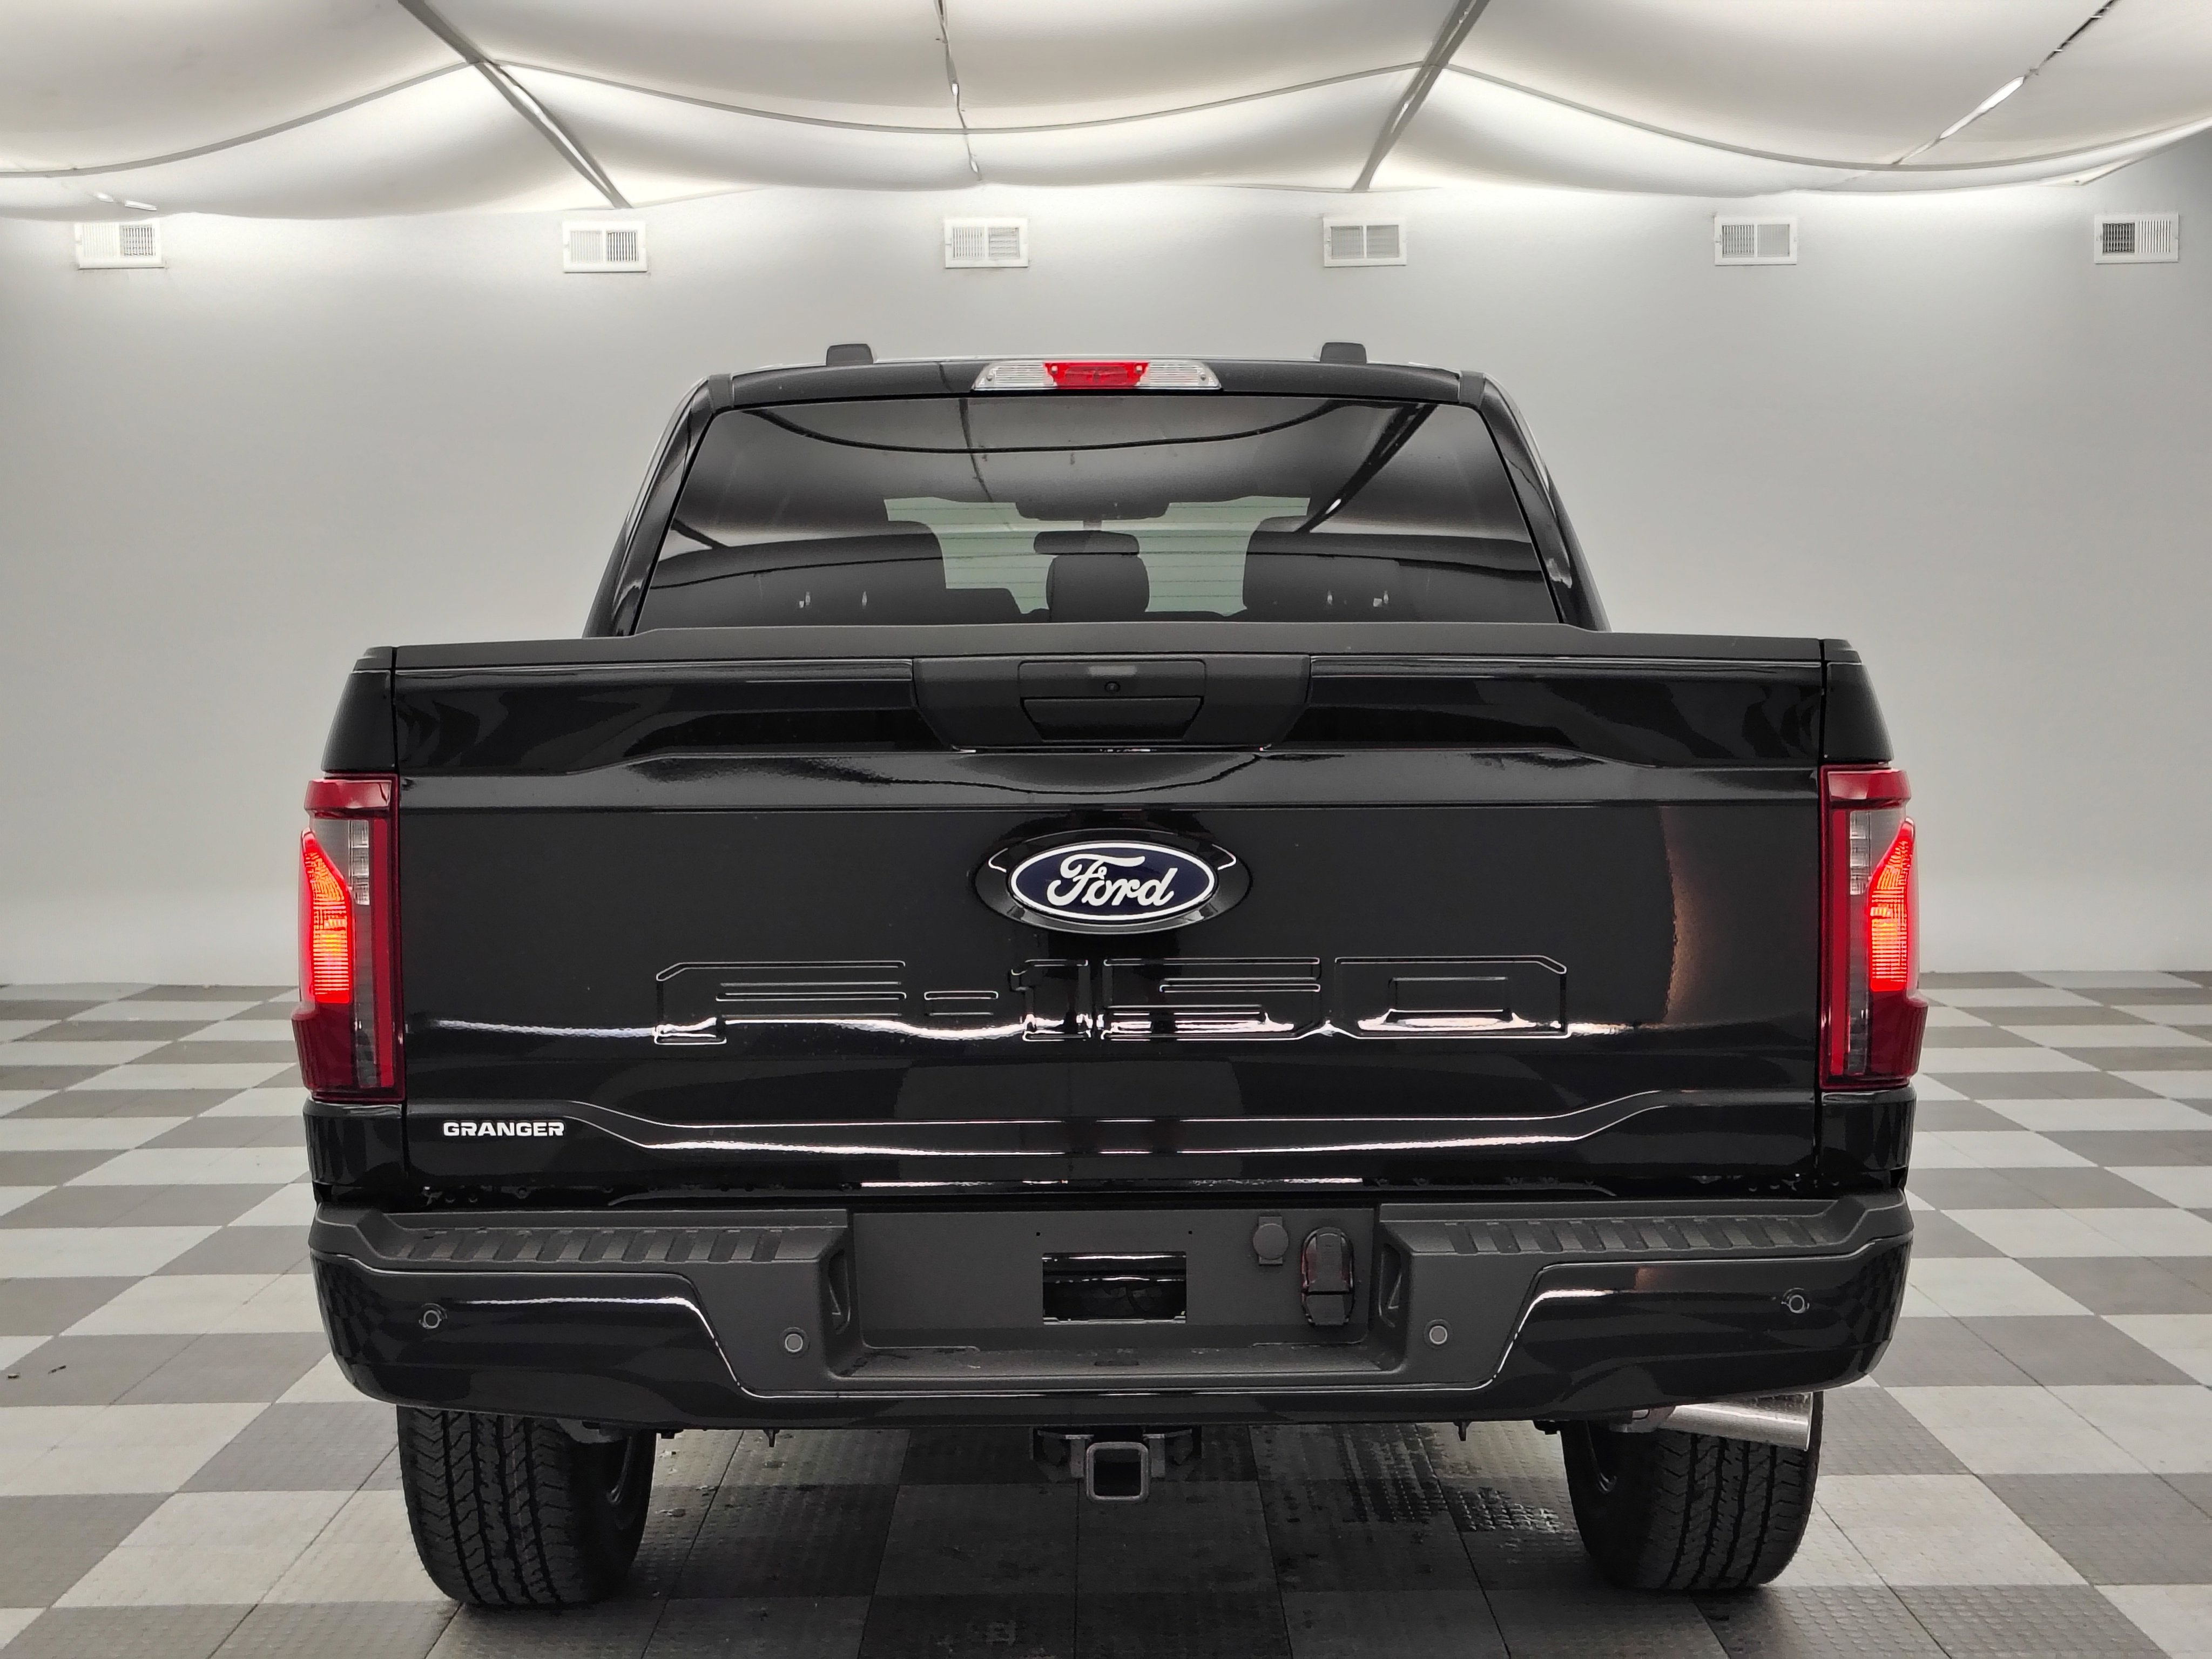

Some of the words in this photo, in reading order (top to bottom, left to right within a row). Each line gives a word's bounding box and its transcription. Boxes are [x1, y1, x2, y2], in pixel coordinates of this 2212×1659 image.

[1047, 853, 1178, 906] Ford
[655, 955, 1568, 1045] F-150
[443, 1122, 565, 1137] GRANGER
